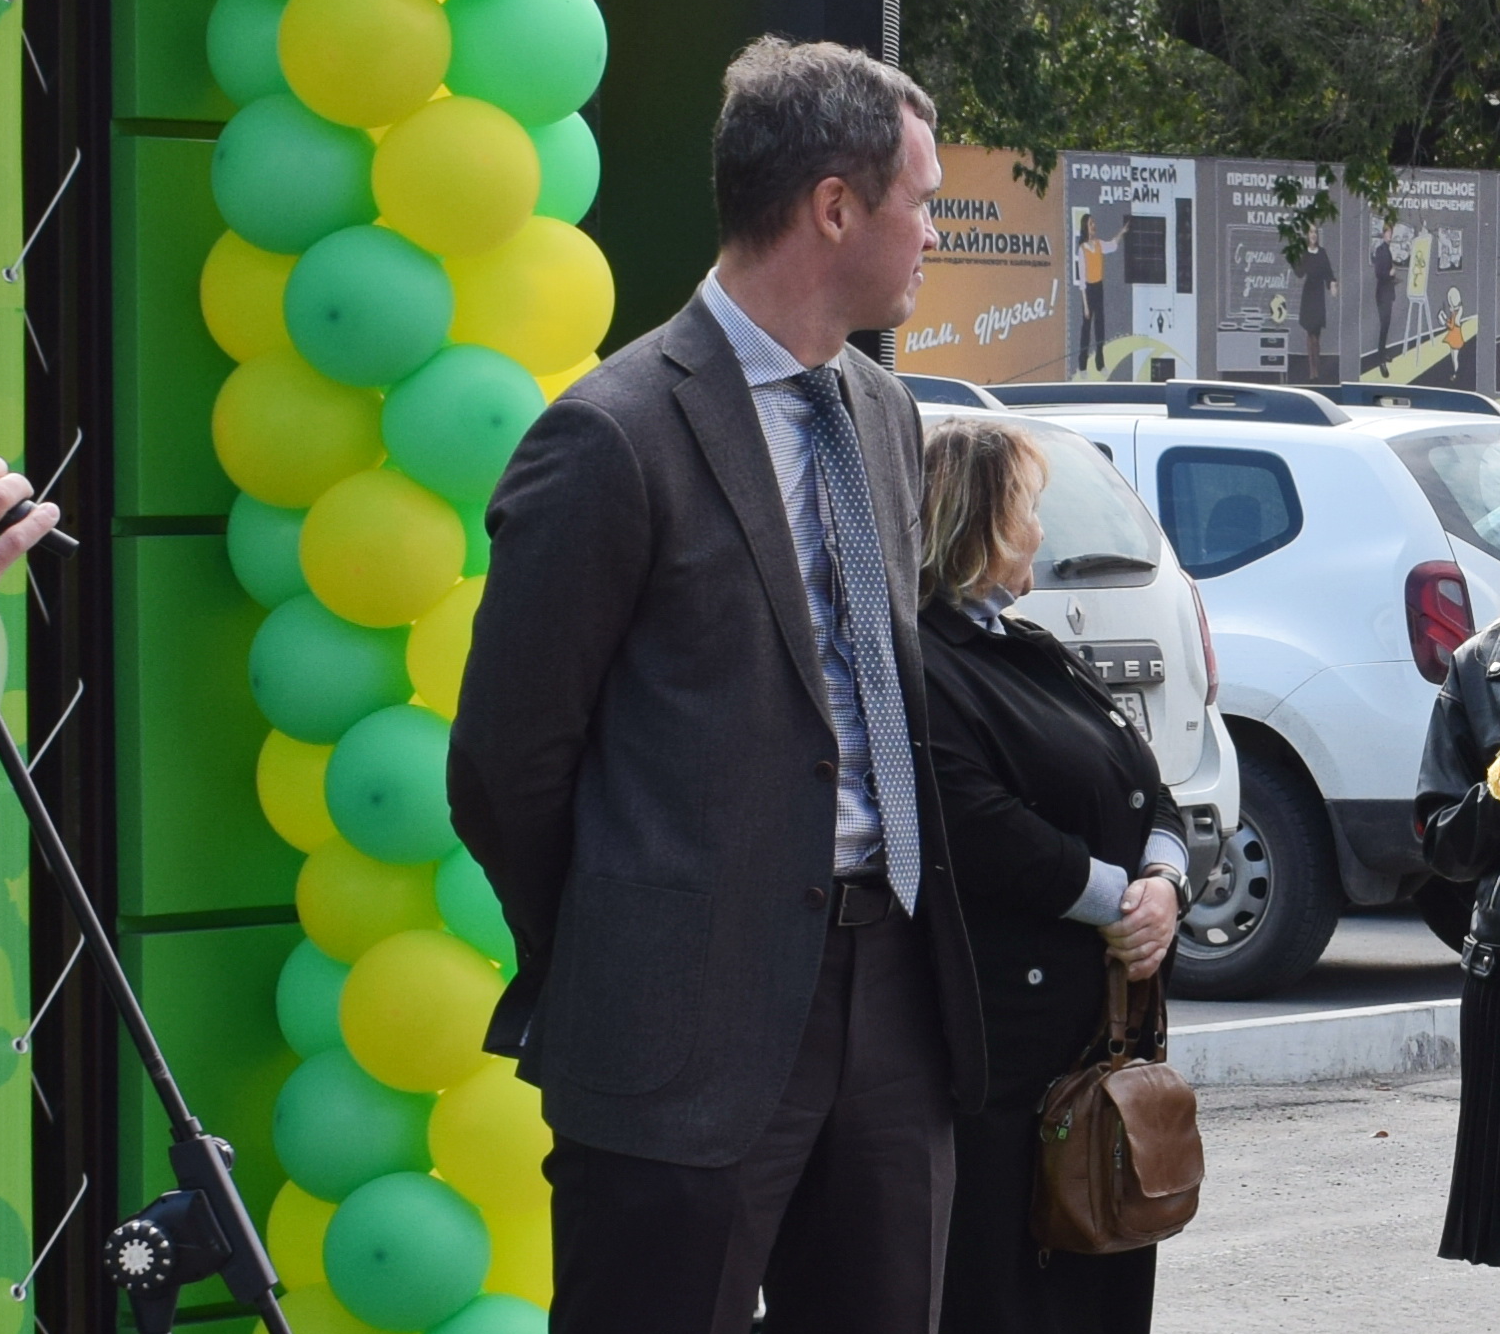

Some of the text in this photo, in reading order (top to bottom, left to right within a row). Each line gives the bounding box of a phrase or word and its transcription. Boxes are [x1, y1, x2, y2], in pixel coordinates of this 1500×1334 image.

[1072, 164, 1177, 184] ГРАФИЧЕСКИЙ
[1099, 185, 1160, 204] ДИЗАЙН
[1232, 192, 1243, 206] В
[928, 198, 1002, 221] ИКИНА
[937, 227, 1051, 256] ХАЙЛОВНА
[905, 278, 1058, 353] нам, друзья!
[1094, 660, 1164, 679] TER
